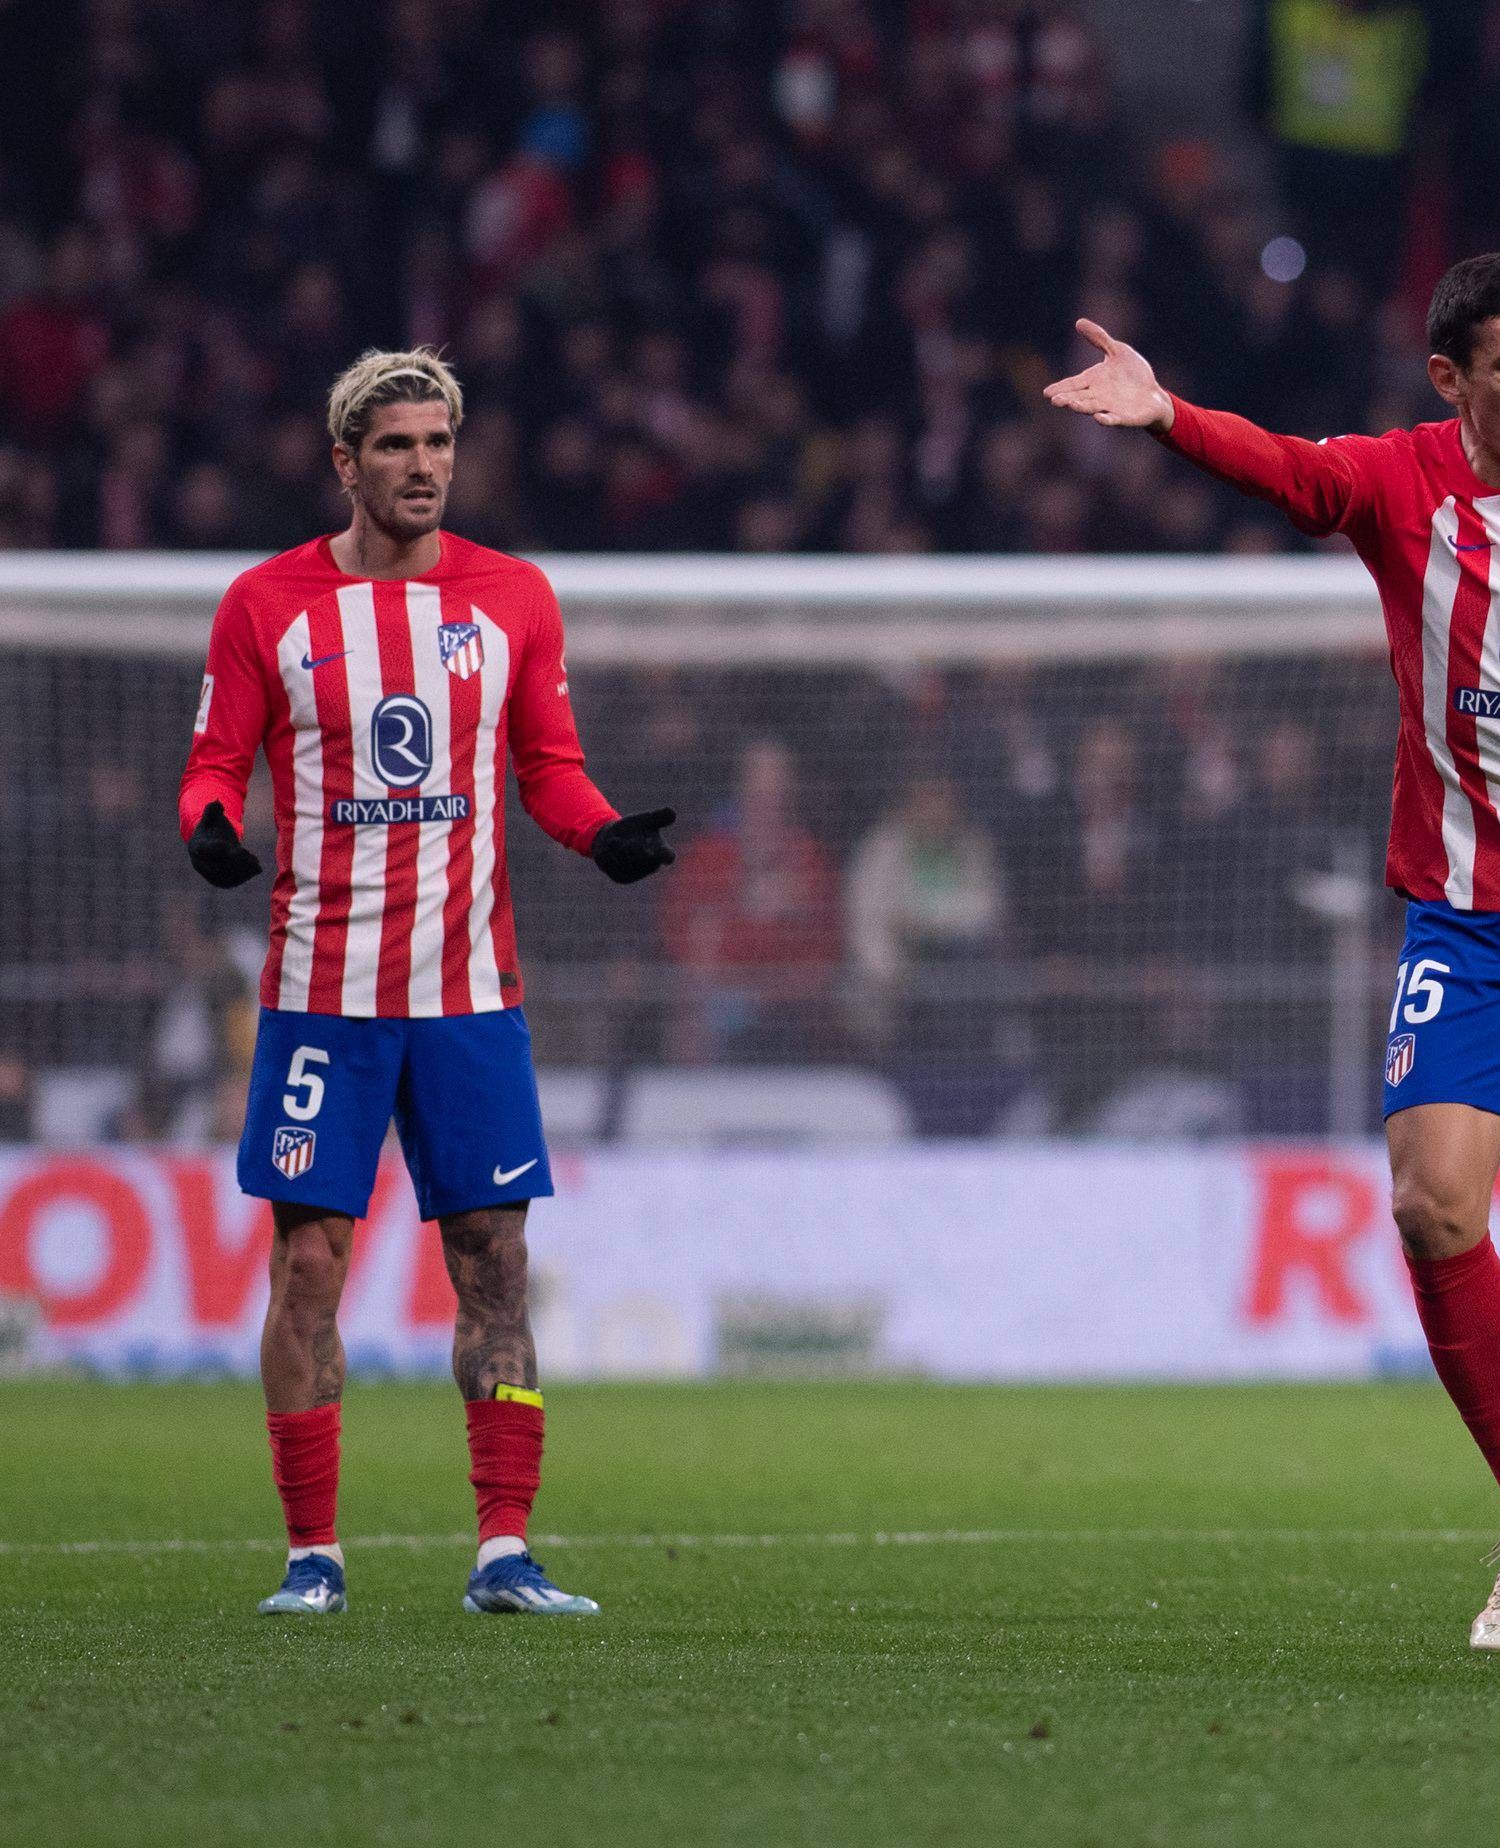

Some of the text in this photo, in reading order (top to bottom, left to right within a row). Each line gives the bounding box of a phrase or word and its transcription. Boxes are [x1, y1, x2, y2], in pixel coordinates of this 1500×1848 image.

[337, 796, 466, 822] RIYADH AIR
[1389, 959, 1451, 1034] 15
[283, 1045, 330, 1121] 5
